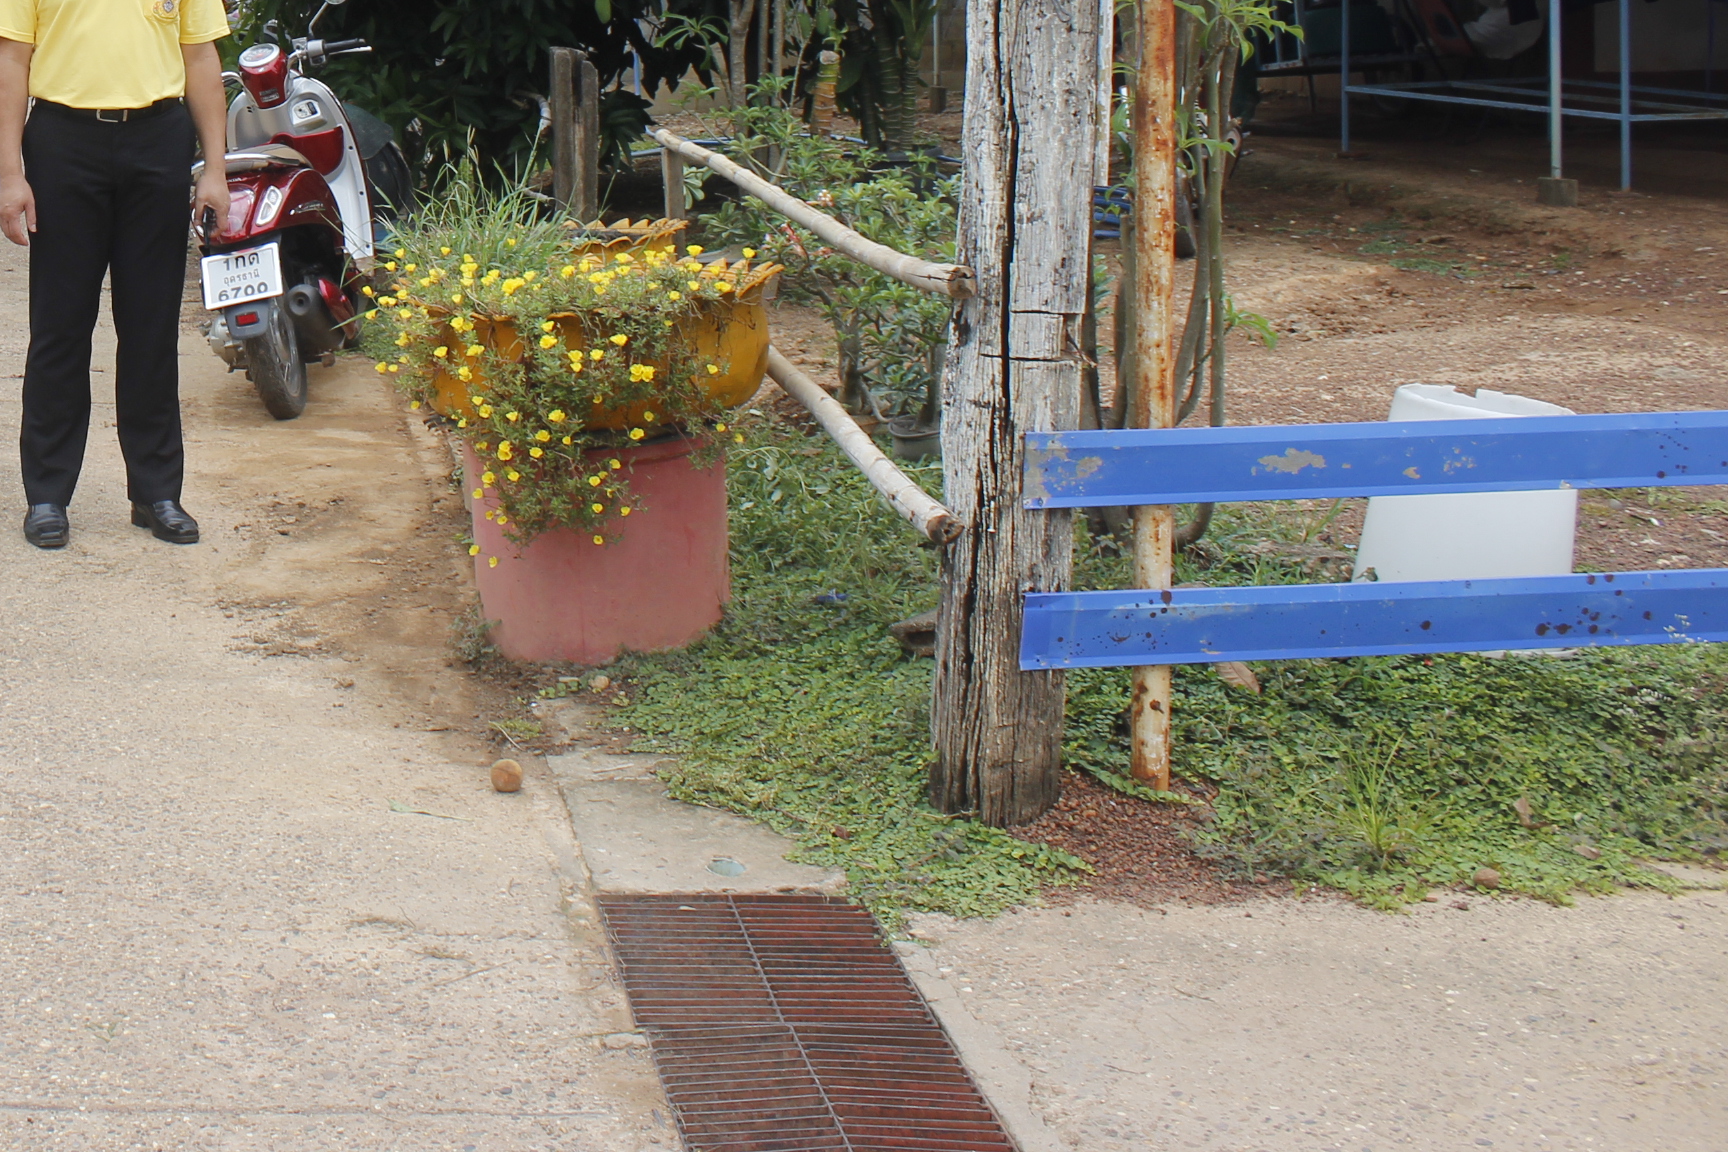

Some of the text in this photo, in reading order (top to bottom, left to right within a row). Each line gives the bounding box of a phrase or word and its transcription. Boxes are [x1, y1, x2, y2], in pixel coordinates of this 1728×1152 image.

[223, 252, 260, 271] 1กด
[223, 268, 260, 286] อุดรธานี
[218, 281, 268, 301] 6700
